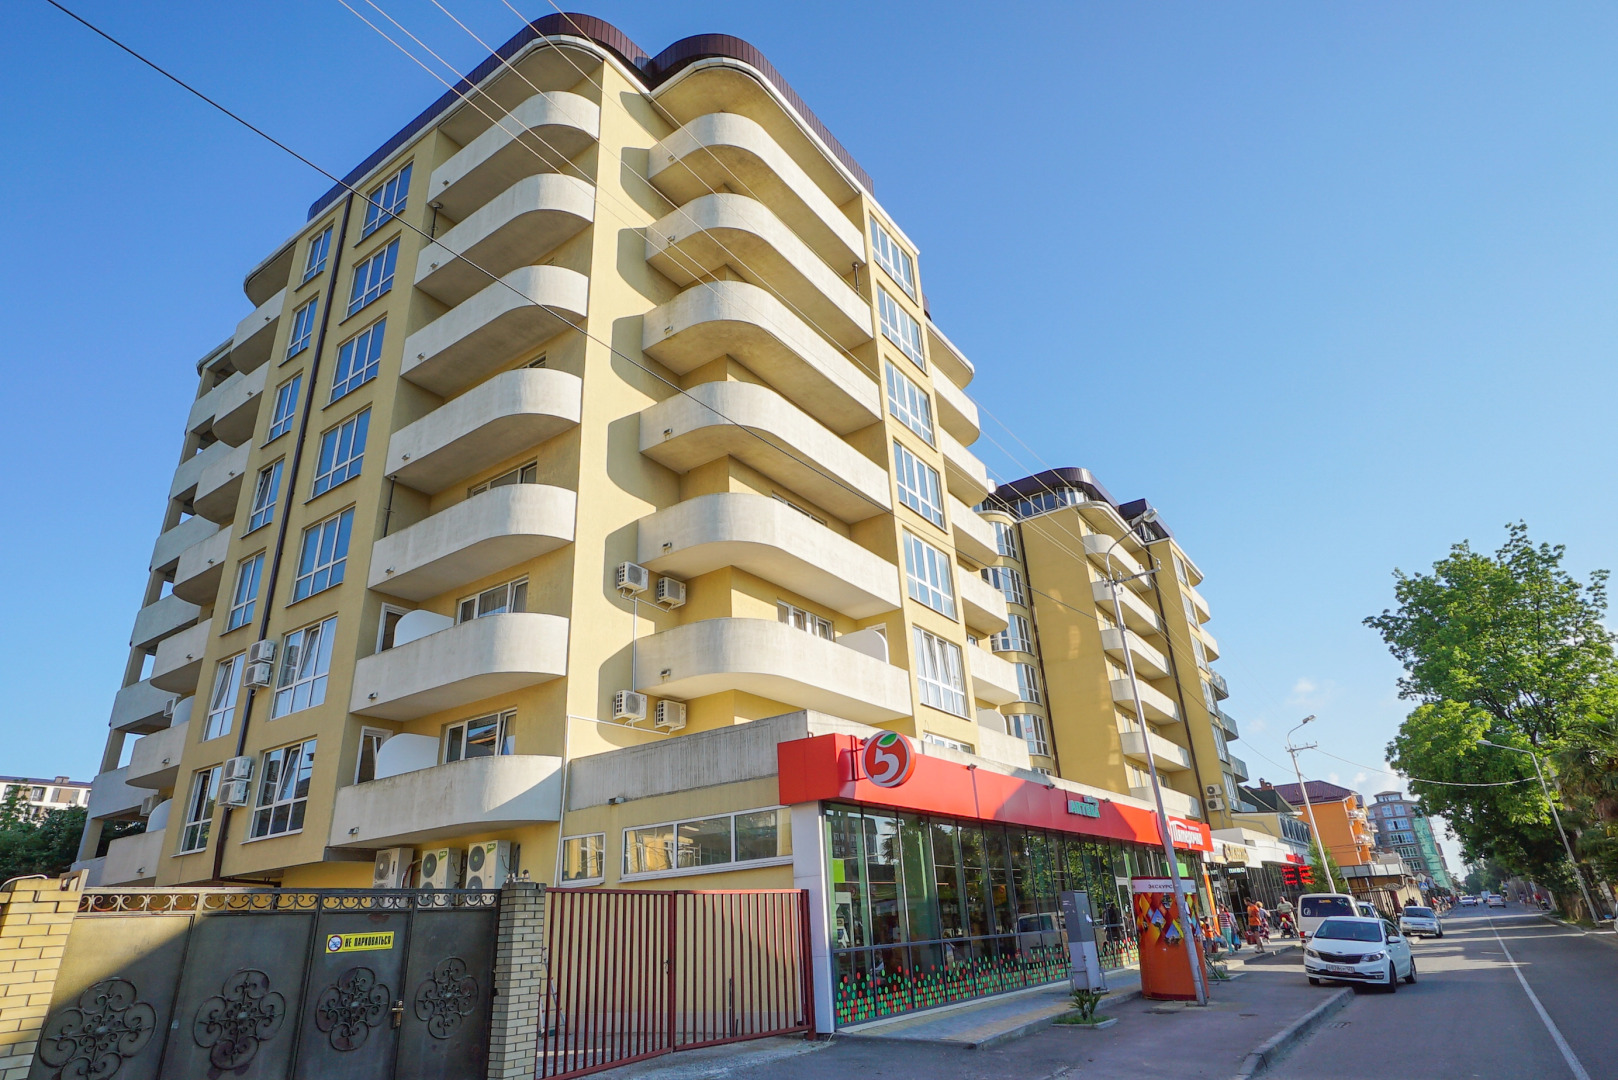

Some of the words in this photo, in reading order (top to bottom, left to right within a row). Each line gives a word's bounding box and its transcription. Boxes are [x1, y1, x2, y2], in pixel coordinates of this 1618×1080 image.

[873, 747, 899, 783] 5
[1068, 799, 1101, 818] АПТЕКА
[345, 938, 352, 947] НЕ
[354, 936, 391, 946] ПАРКОВАТЬСЯ
